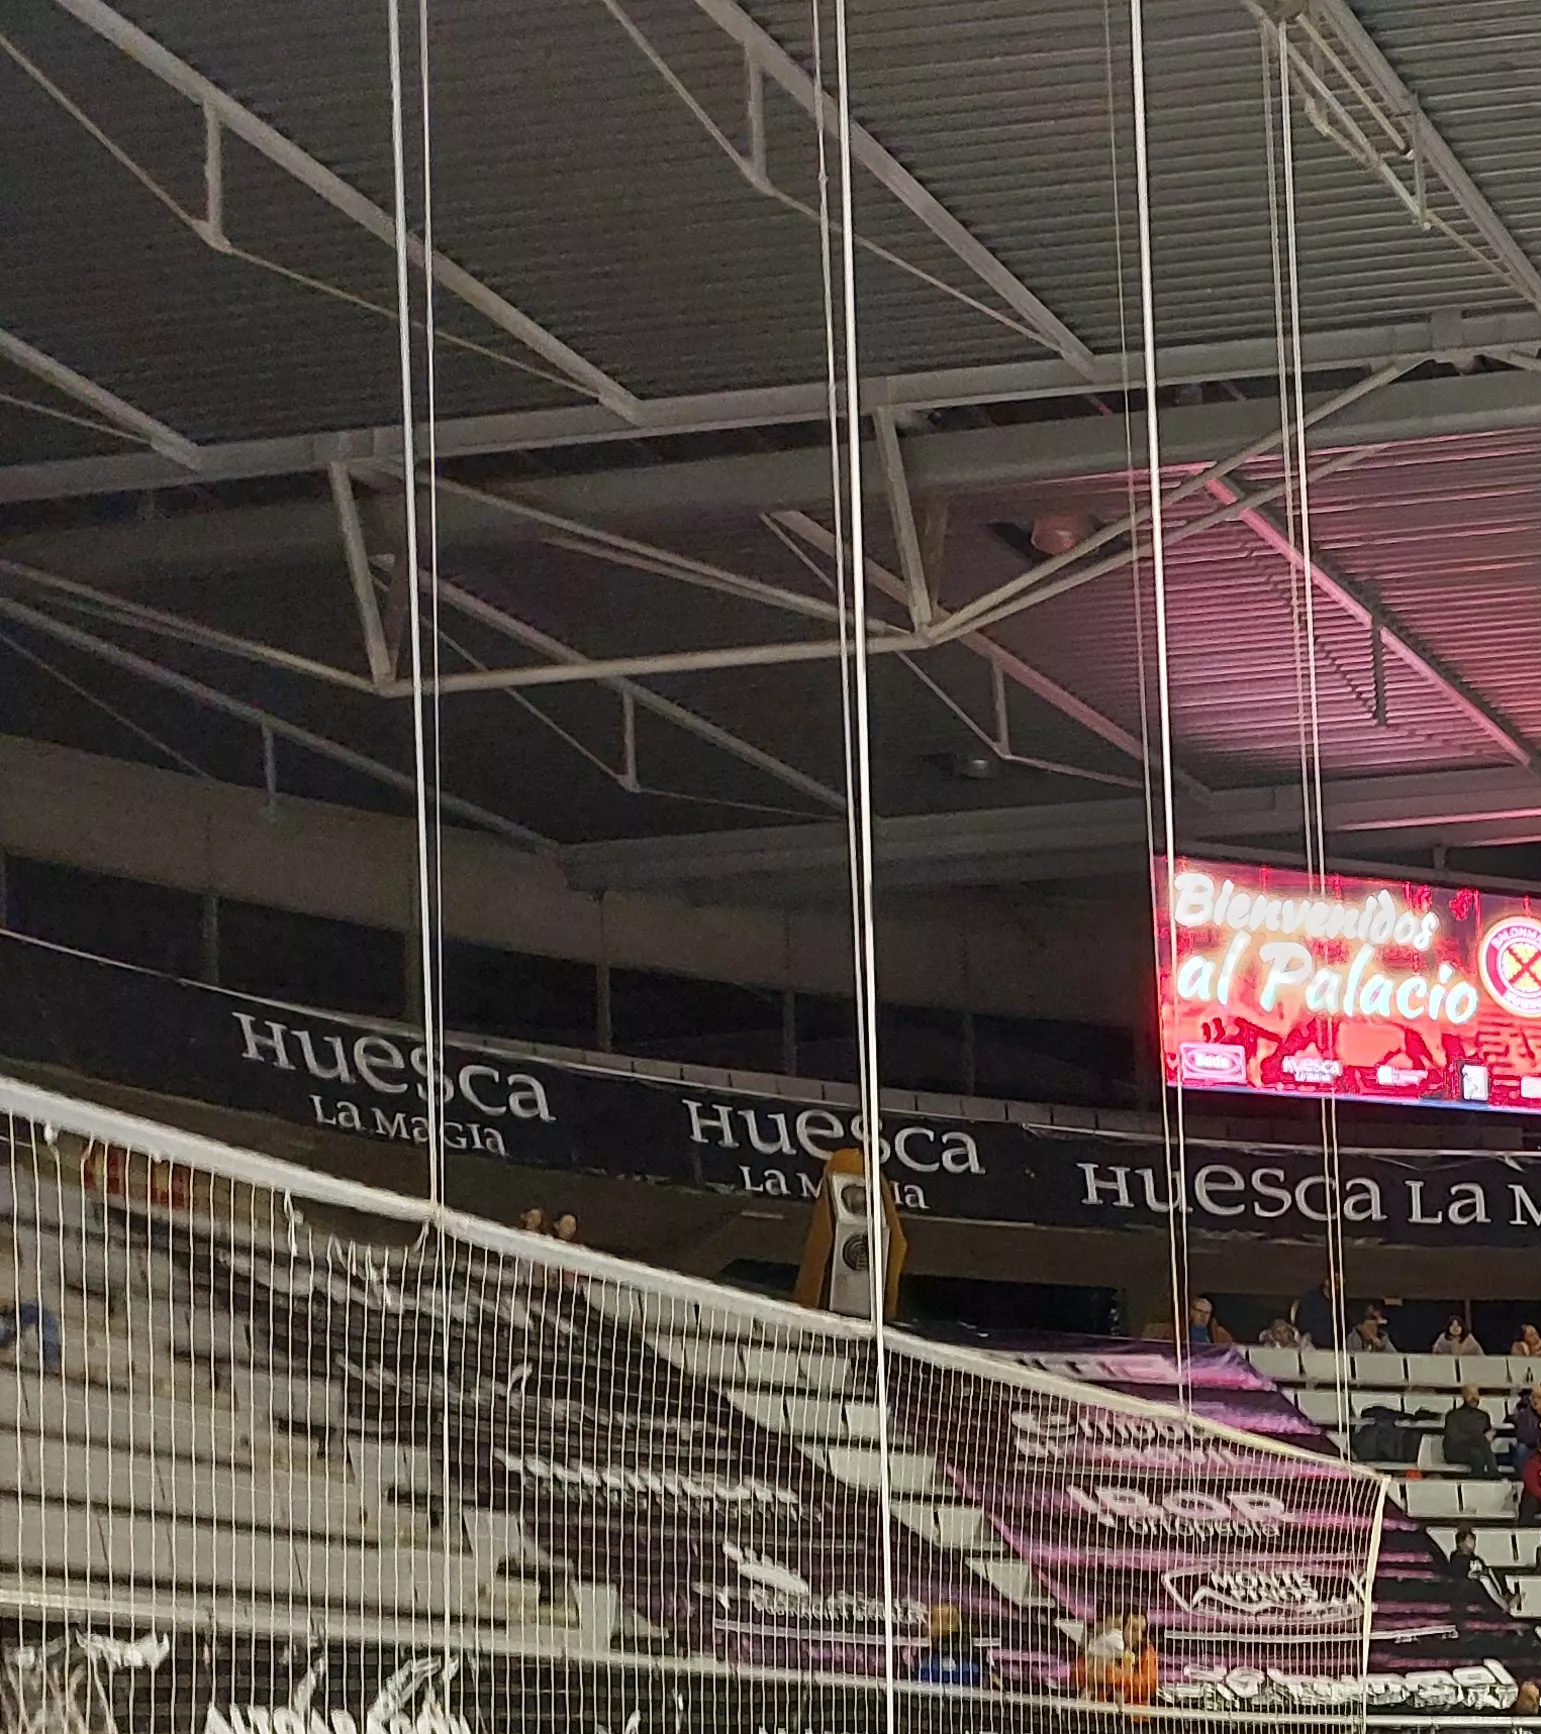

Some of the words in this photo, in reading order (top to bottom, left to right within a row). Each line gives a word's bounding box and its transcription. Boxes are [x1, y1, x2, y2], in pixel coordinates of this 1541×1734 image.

[1174, 872, 1440, 951] Bienvenidos
[1178, 931, 1251, 1006] al
[1259, 942, 1478, 1025] Palacio
[231, 1011, 556, 1124] Huesca
[309, 1094, 361, 1131] La
[682, 1098, 985, 1176] Huesca
[739, 1165, 791, 1197] La
[1077, 1161, 1387, 1223] Huesca
[1405, 1179, 1491, 1224] La
